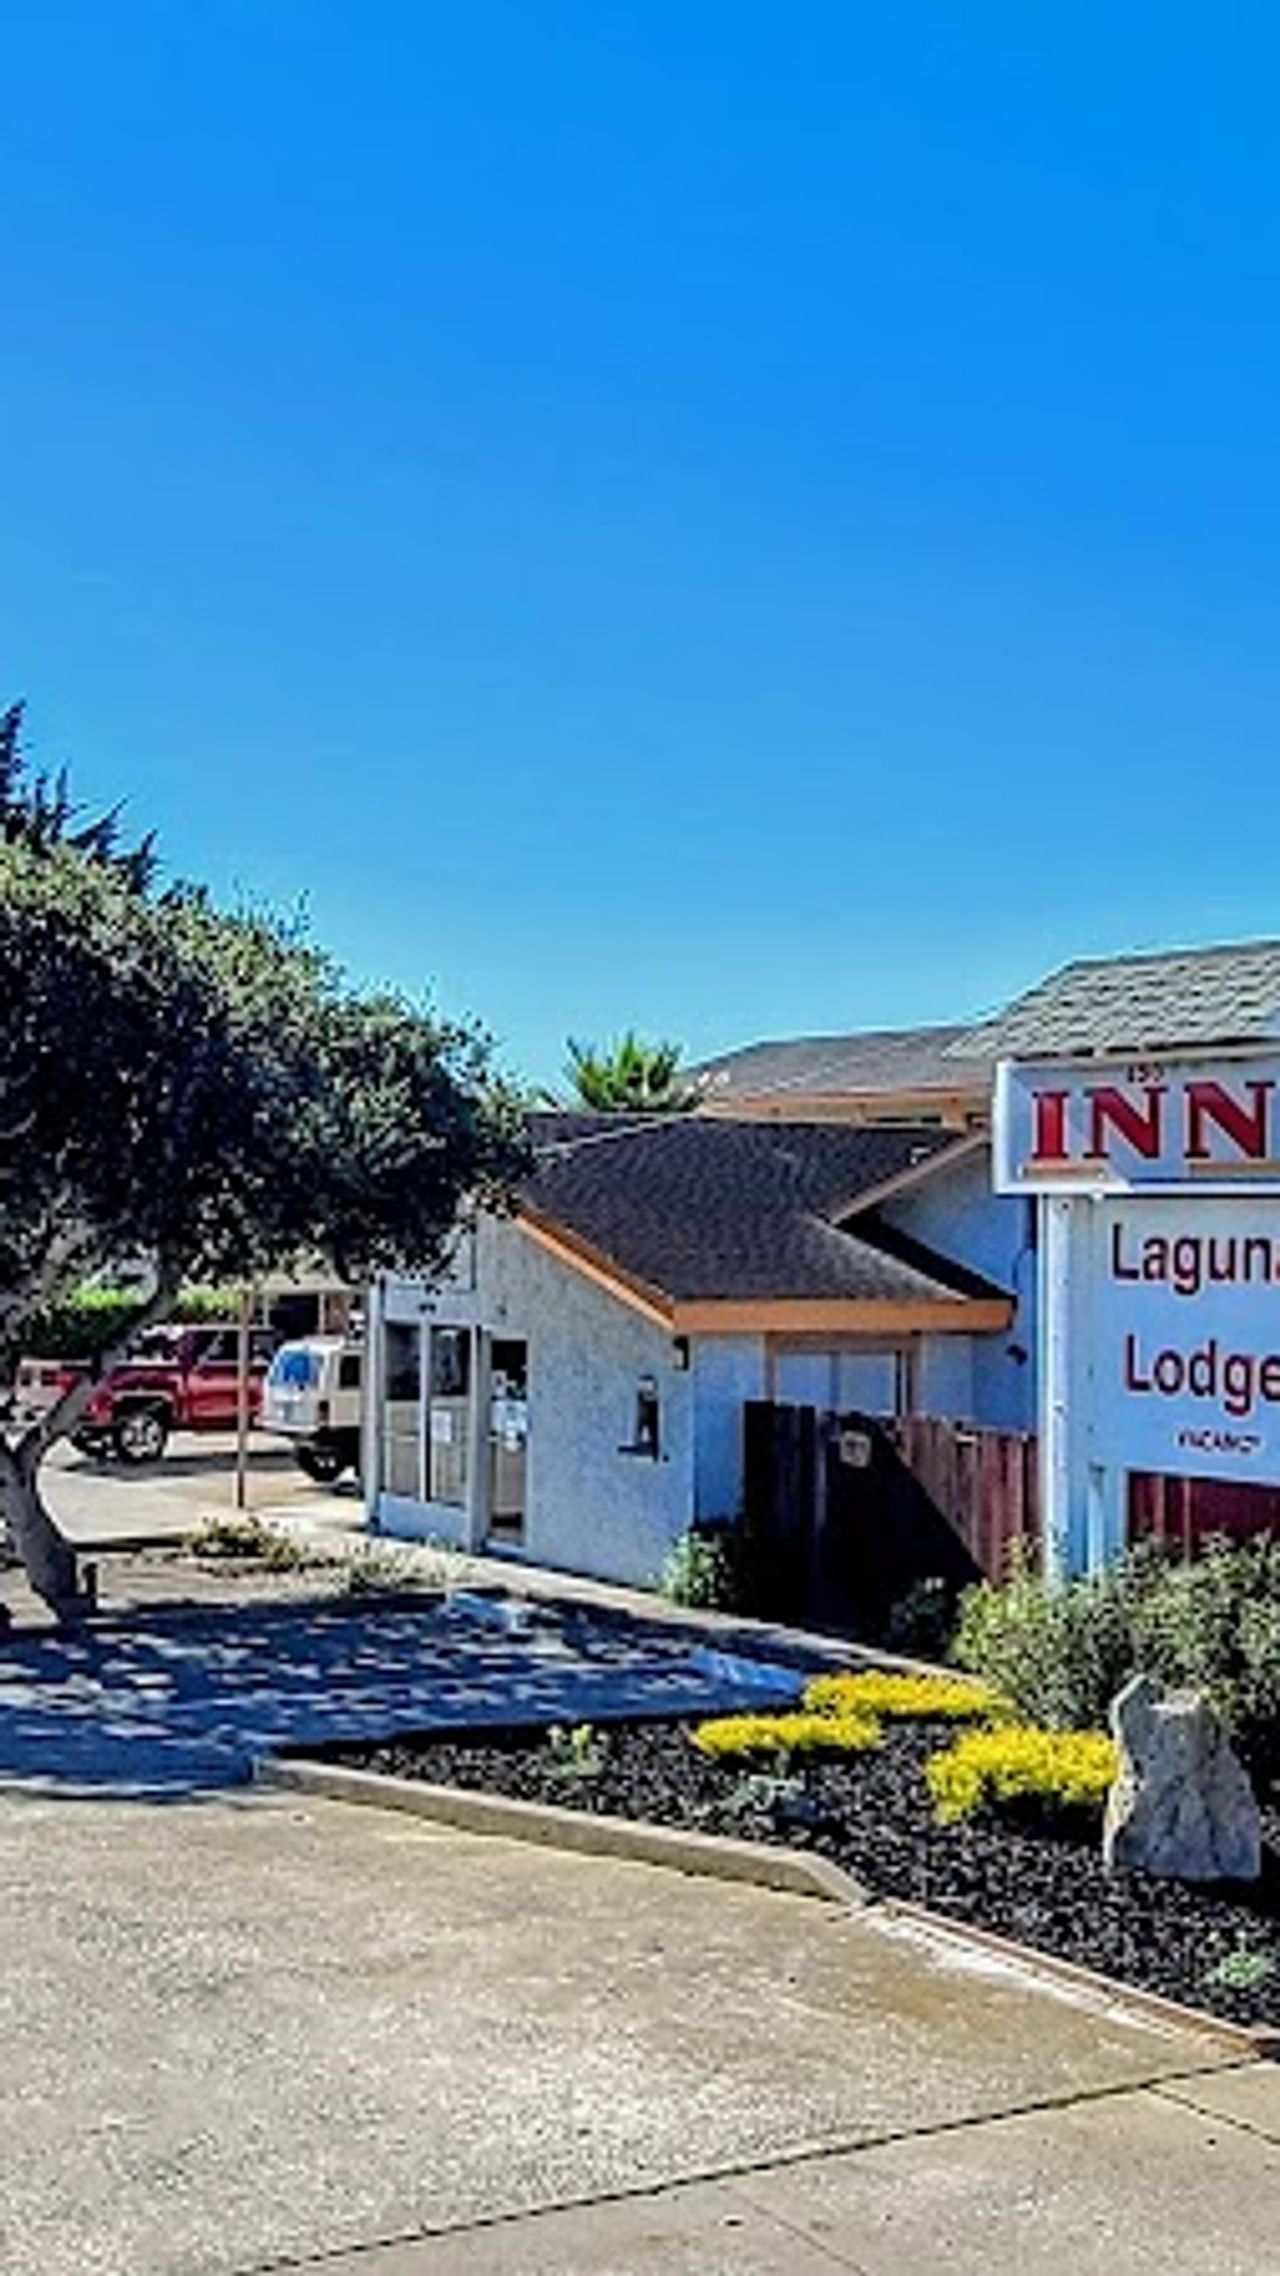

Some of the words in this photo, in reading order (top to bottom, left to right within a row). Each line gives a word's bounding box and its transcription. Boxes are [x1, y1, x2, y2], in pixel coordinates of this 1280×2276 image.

[1031, 1080, 1276, 1160] INN
[1112, 1222, 1280, 1295] Lagun
[1124, 1333, 1280, 1416] Lodge
